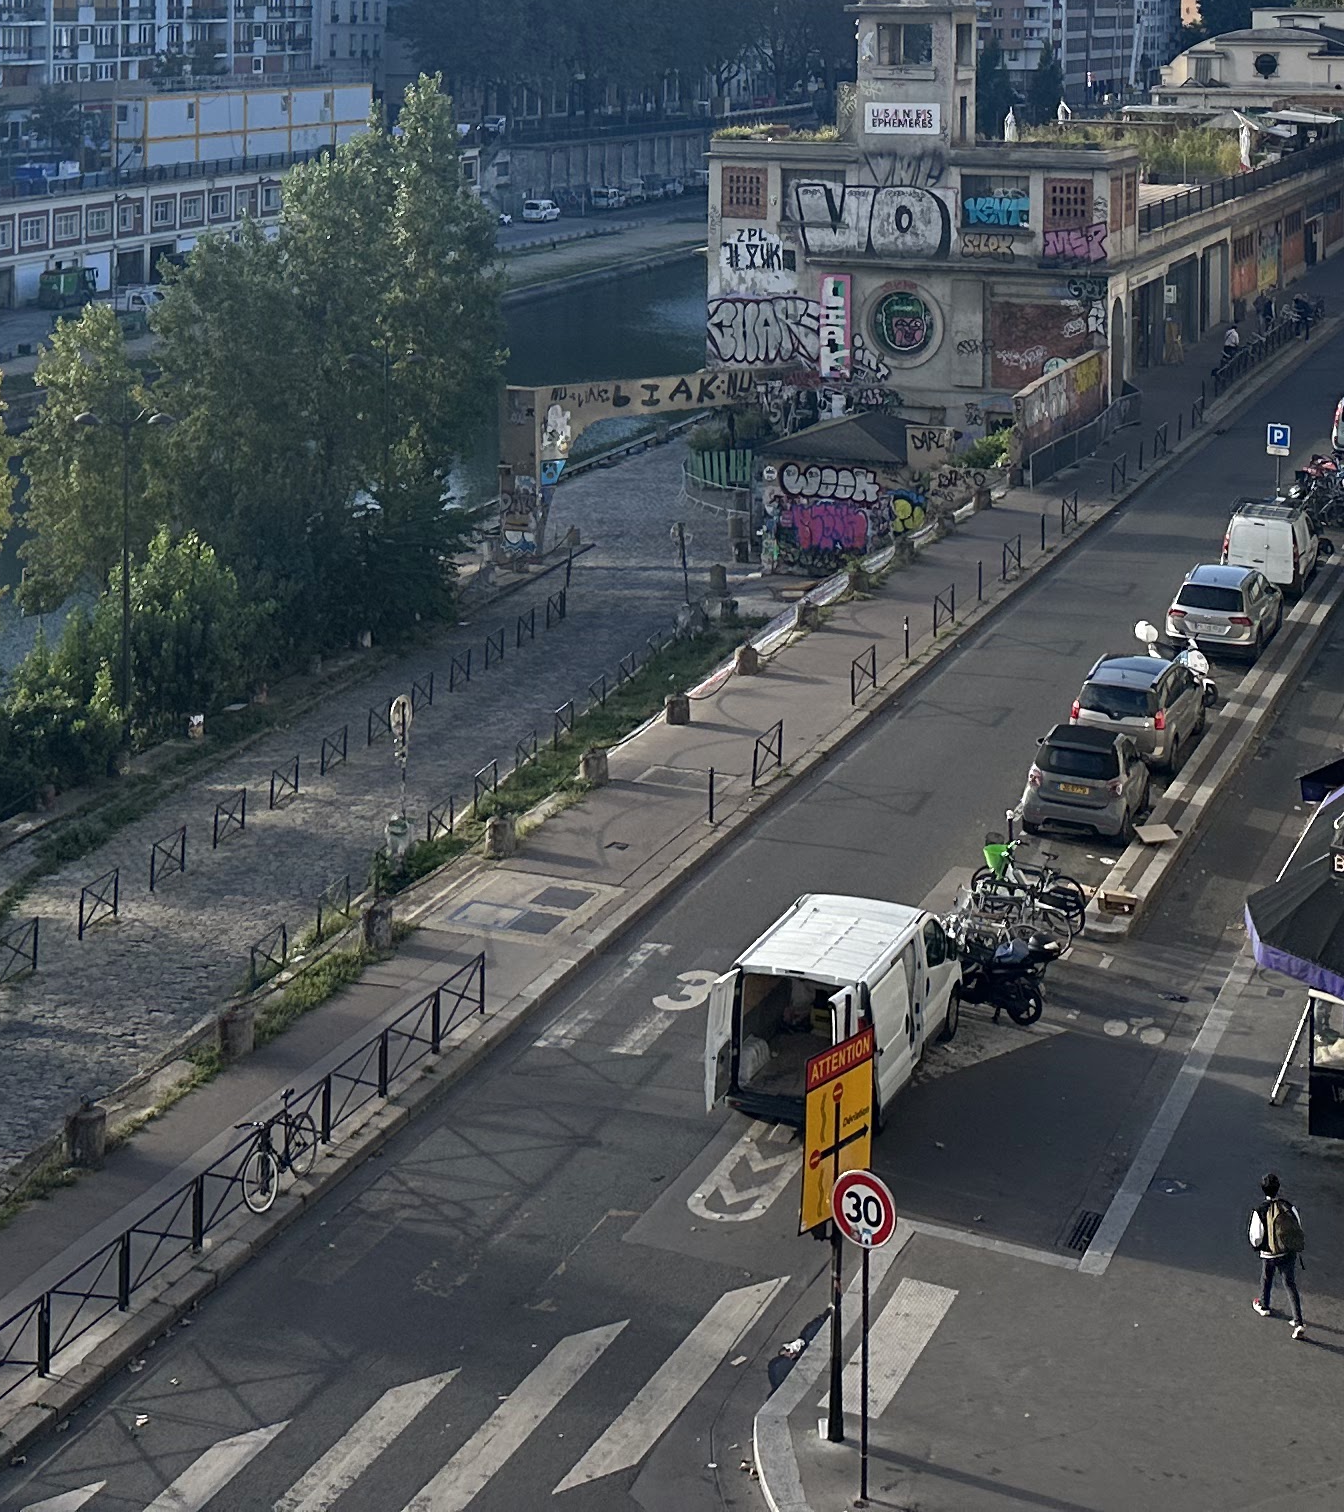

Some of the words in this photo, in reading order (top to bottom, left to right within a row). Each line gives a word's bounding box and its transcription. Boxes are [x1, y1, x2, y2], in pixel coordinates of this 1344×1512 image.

[871, 108, 933, 119] USINES
[872, 118, 933, 128] EPHEMERES
[736, 228, 768, 243] ZPL
[1273, 429, 1284, 443] P
[810, 1035, 871, 1083] ATTENTION
[845, 1191, 883, 1228] 30
